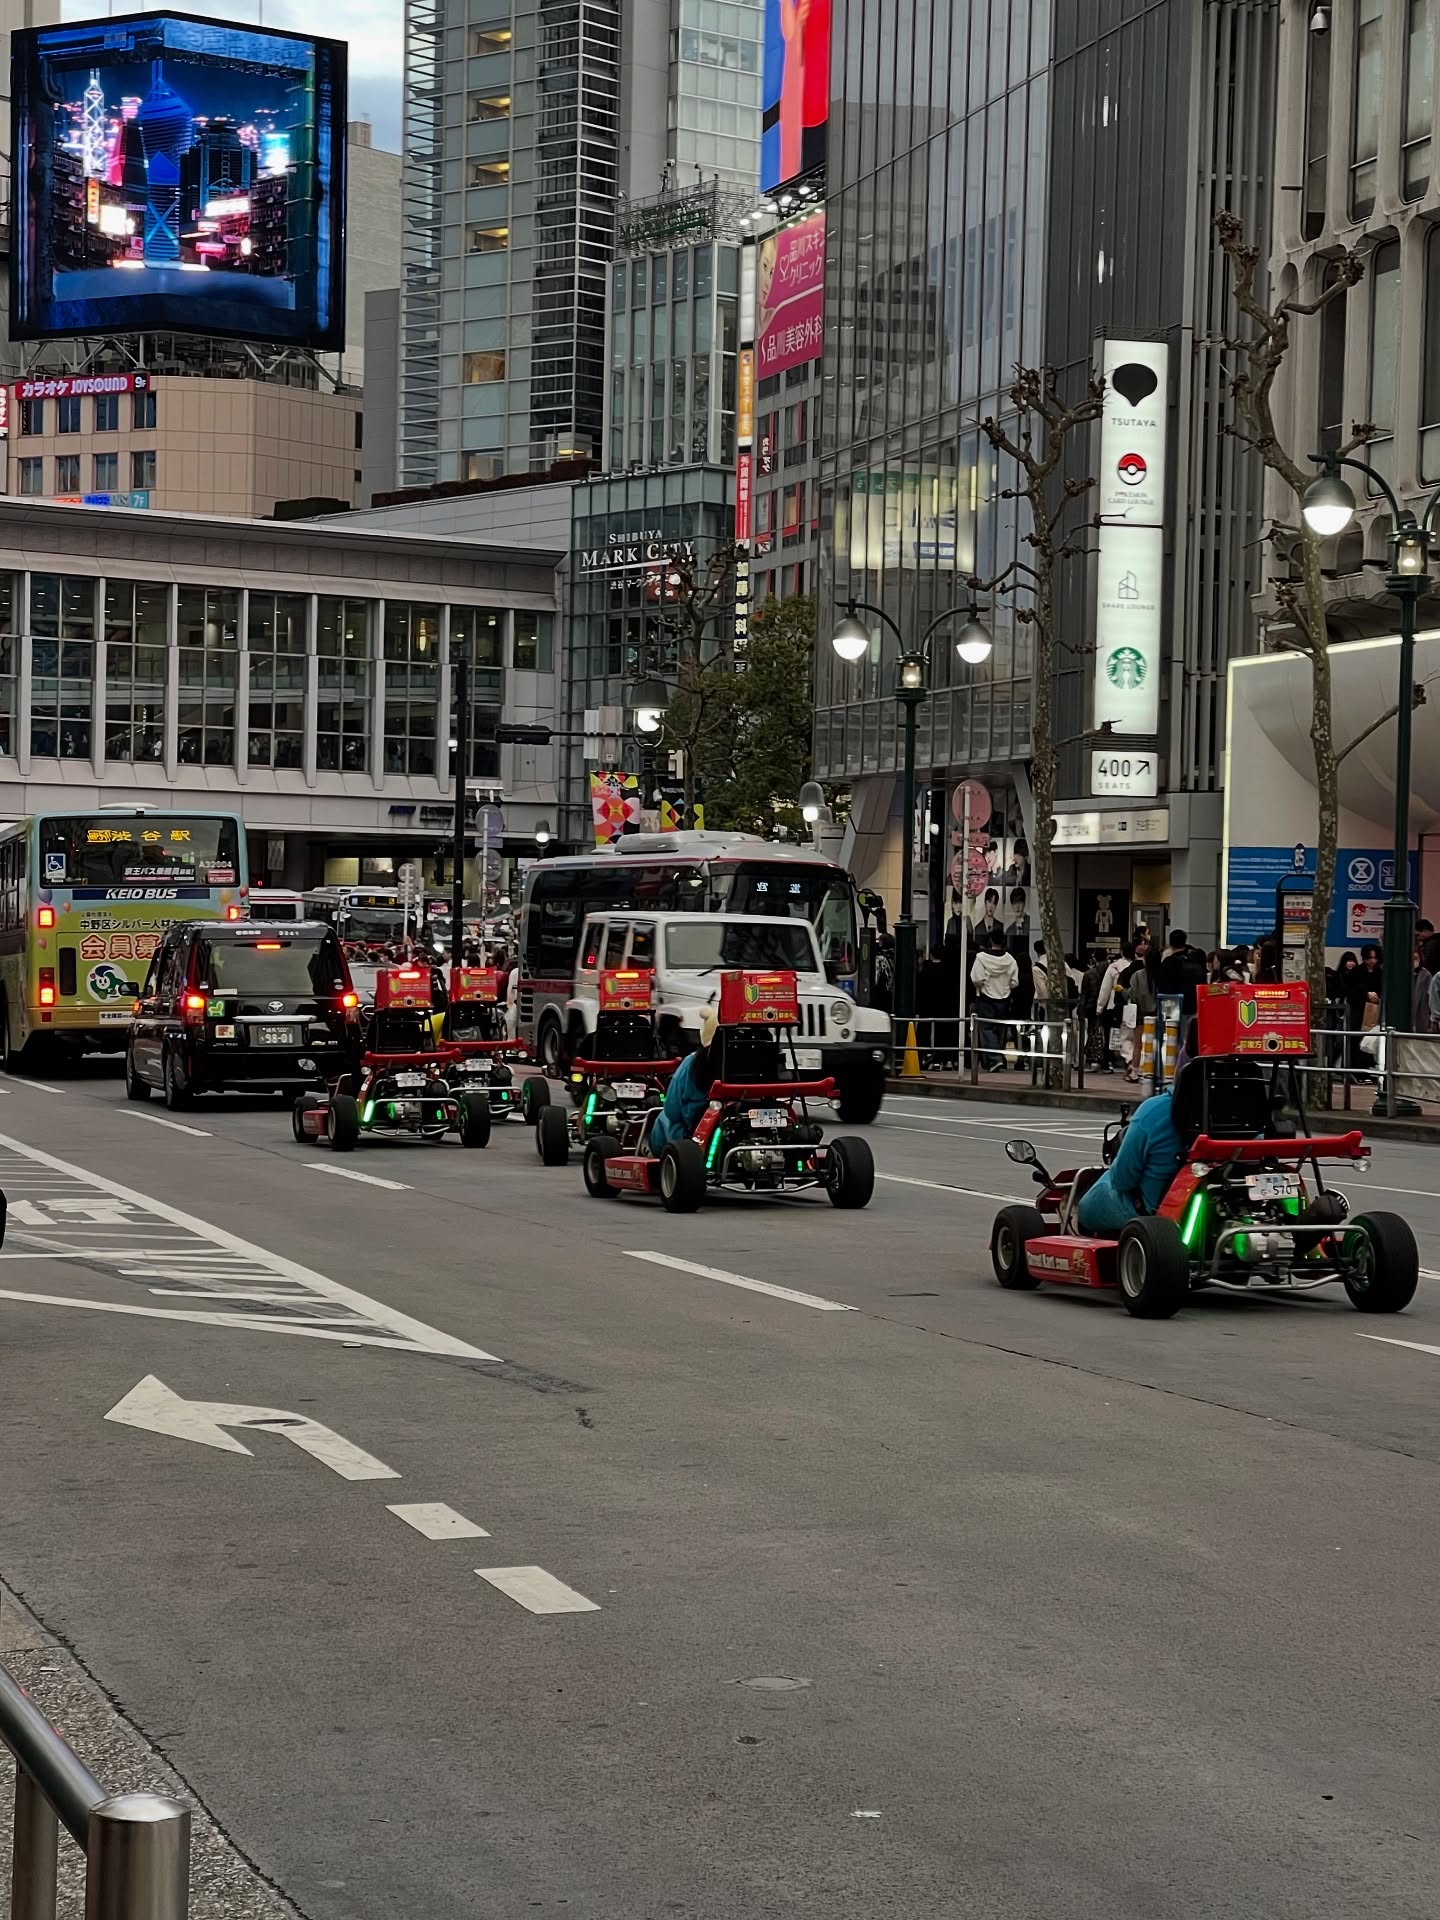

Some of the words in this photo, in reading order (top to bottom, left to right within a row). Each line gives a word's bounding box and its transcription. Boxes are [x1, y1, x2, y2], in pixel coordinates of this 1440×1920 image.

[789, 254, 823, 288] クリニック
[766, 314, 823, 363] 品川美容外科
[22, 380, 69, 397] カラオケ
[71, 377, 128, 394] JOYSOUND
[1111, 417, 1157, 427] TSUTAYA
[133, 495, 145, 507] 7F
[609, 530, 662, 544] SHIBUYA
[582, 547, 638, 567] MARK
[646, 541, 694, 560] CITY
[1098, 760, 1131, 777] 400
[1097, 781, 1131, 790] SEATS
[106, 888, 143, 900] KEIO
[144, 888, 178, 899] BUS
[1352, 920, 1362, 933] 5
